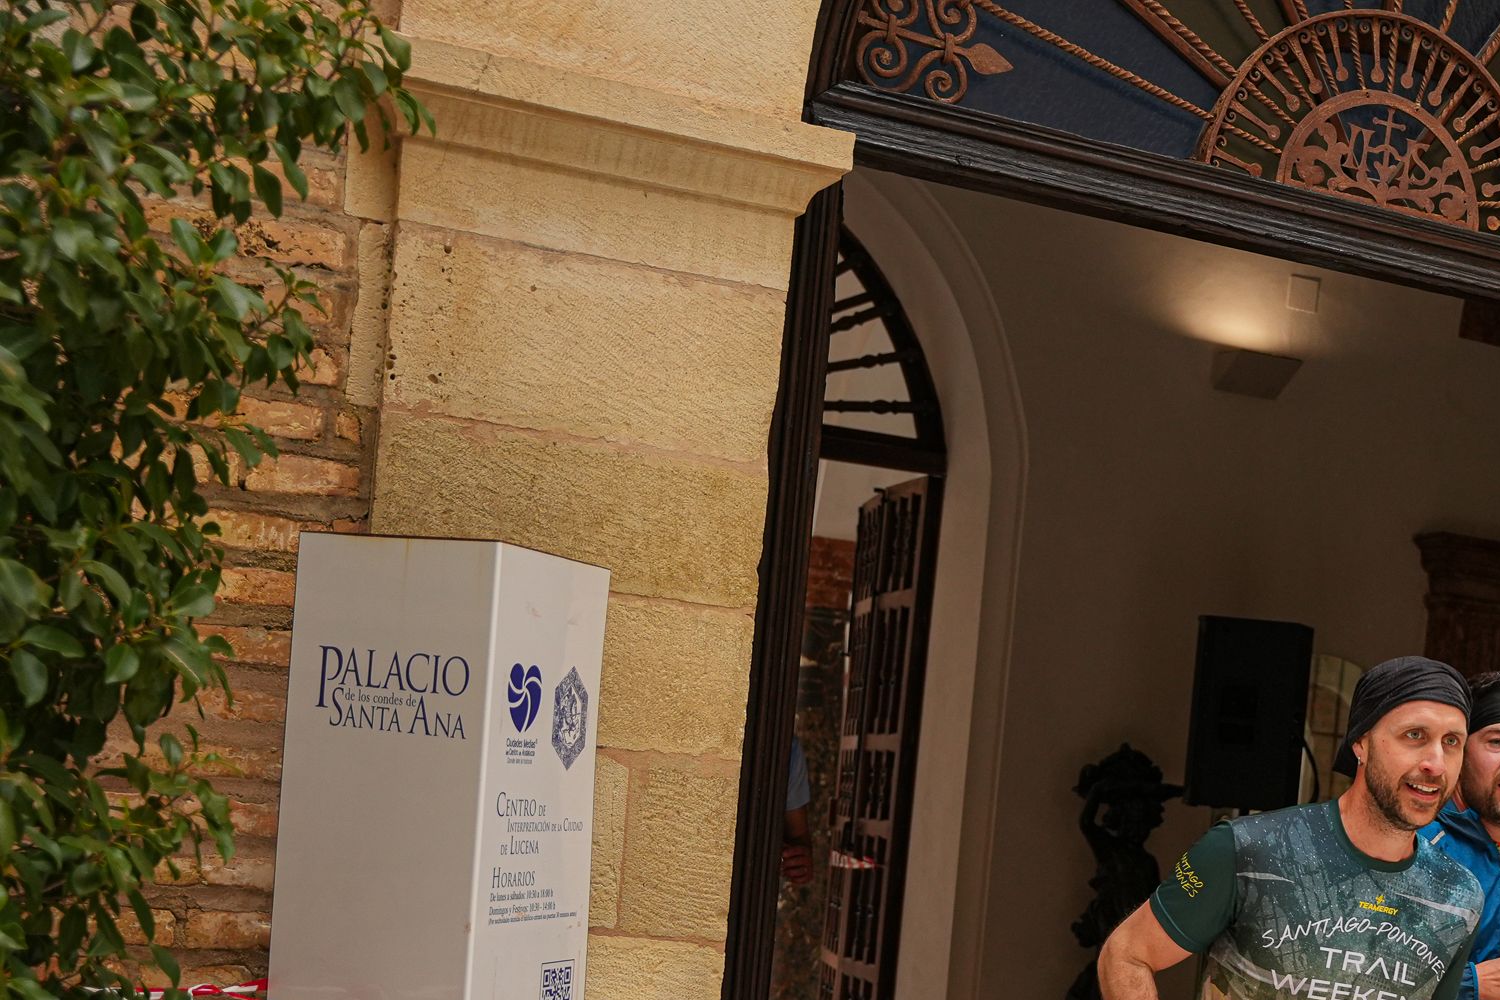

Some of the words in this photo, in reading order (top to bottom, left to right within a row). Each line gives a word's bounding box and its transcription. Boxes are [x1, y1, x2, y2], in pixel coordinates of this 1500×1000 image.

[315, 645, 470, 708] PALACIO
[345, 688, 355, 701] de
[358, 689, 370, 702] los
[373, 692, 403, 706] condes
[405, 694, 417, 707] de
[329, 687, 402, 733] SANTA
[407, 695, 467, 740] ANA
[496, 791, 537, 817] CENTRO
[538, 805, 546, 817] DE
[500, 844, 508, 855] DE
[510, 835, 539, 855] LUCENA
[492, 867, 536, 889] HORARIOS
[1359, 901, 1399, 916] TEAMERGY
[1319, 946, 1416, 986] TRAIL
